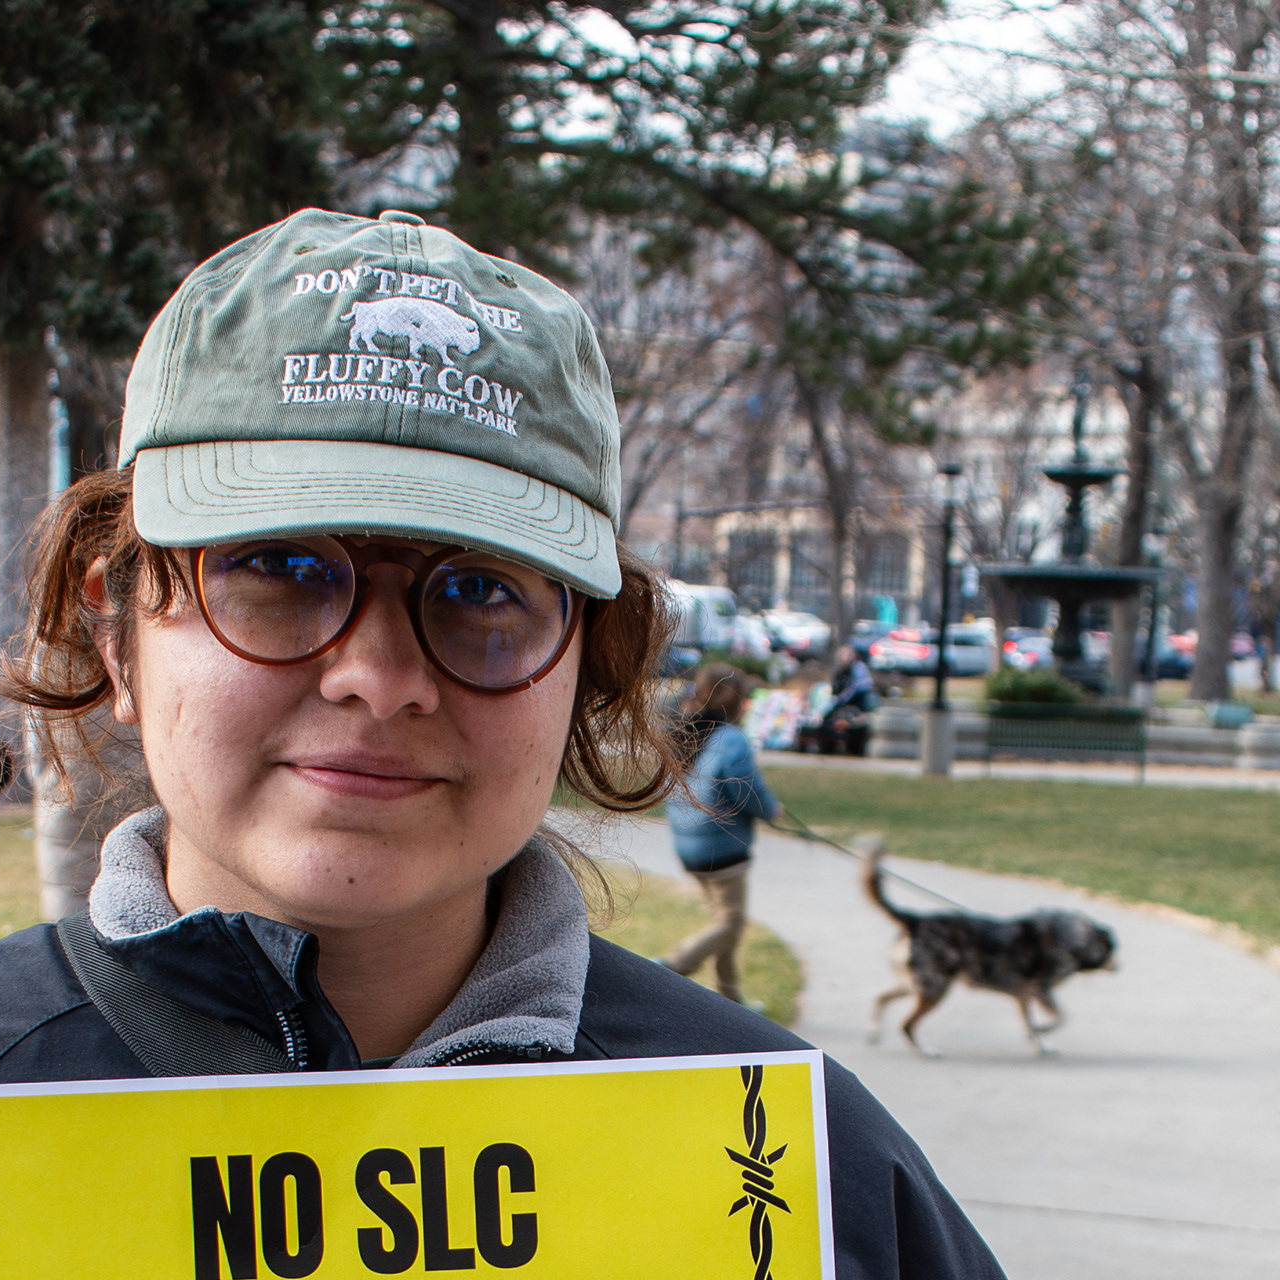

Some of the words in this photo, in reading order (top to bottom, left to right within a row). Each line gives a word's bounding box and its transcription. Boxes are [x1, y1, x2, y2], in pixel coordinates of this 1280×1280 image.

[292, 264, 397, 297] DON'T
[398, 271, 462, 306] PET
[277, 383, 419, 406] YELLOWSTONE
[474, 405, 519, 438] PARK
[281, 353, 432, 389] FLUFFY
[437, 366, 524, 418] COW
[354, 1142, 539, 1275] SLC
